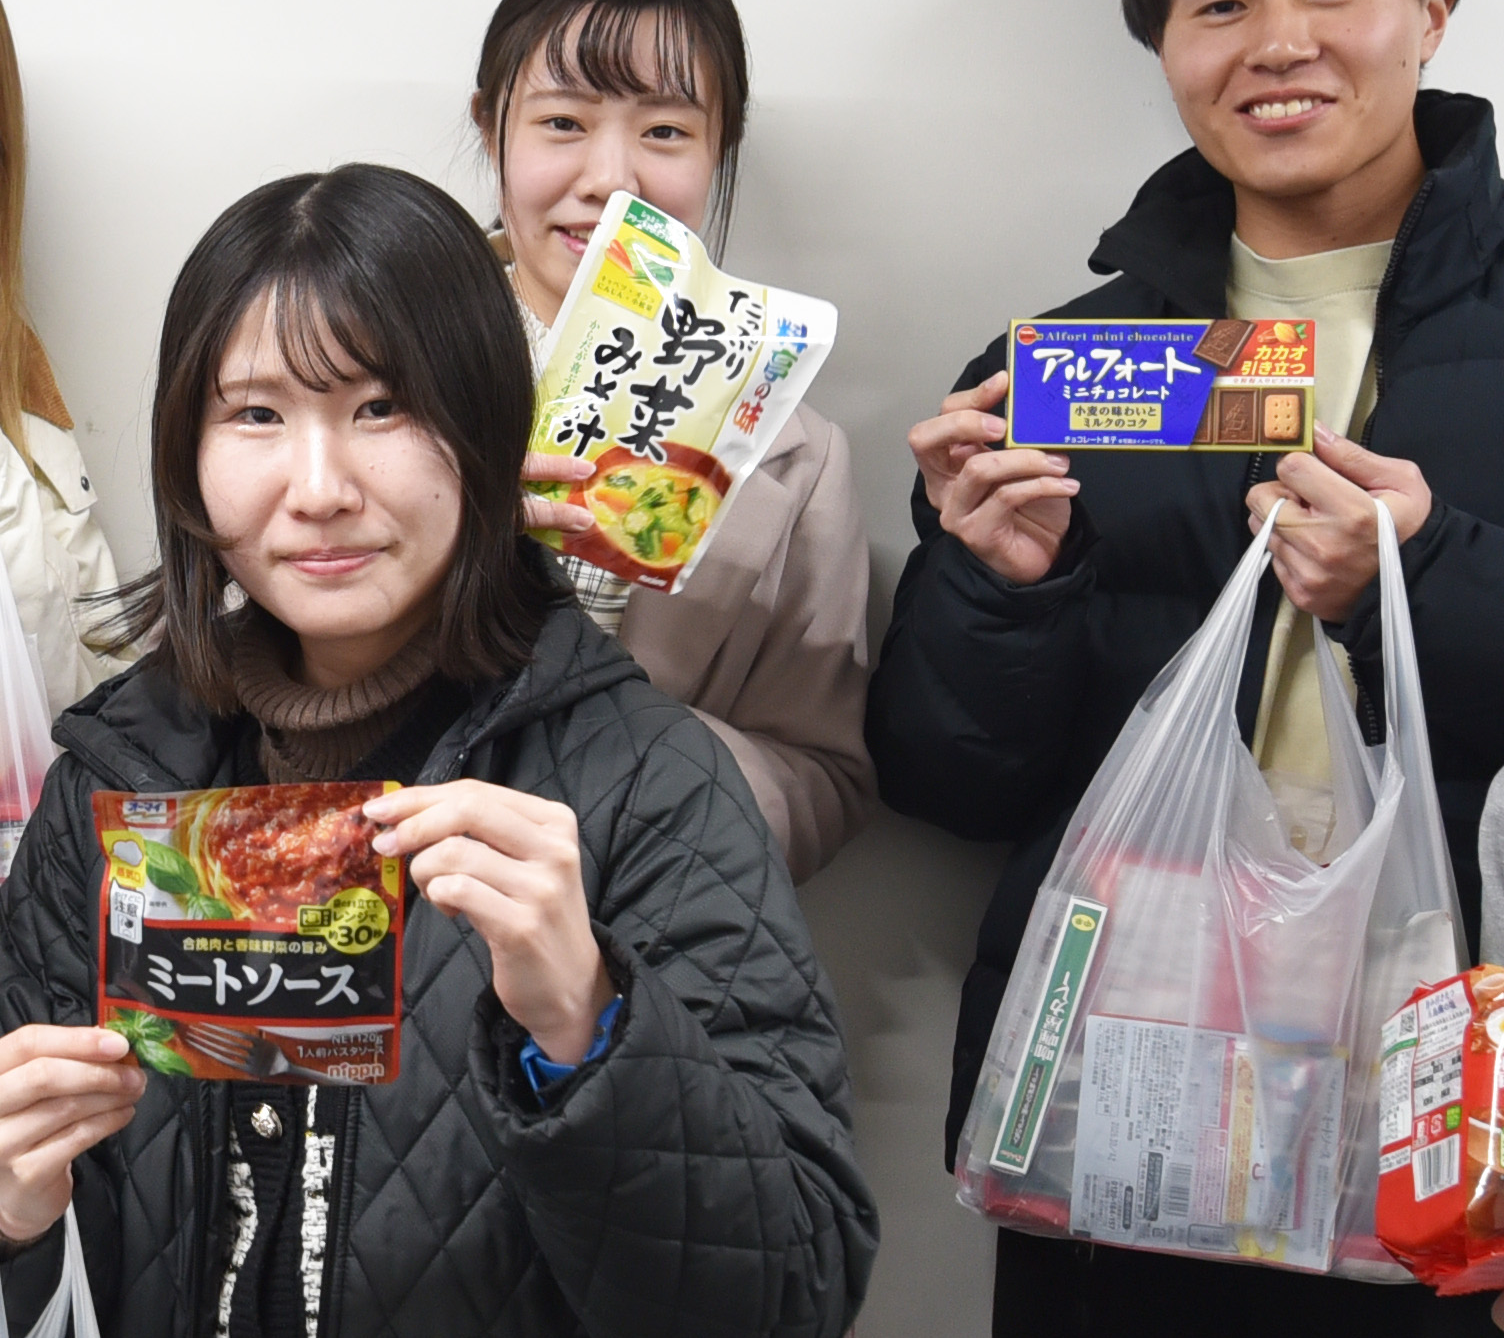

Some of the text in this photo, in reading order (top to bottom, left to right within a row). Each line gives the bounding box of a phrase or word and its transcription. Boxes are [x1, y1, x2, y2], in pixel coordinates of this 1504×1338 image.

[1045, 332, 1194, 342] Alfort mini chocolate
[1254, 345, 1308, 361] カカオ
[1032, 346, 1202, 384] アルフォート
[1241, 360, 1307, 376] 引き立つ
[616, 294, 726, 463] 野菜
[732, 317, 809, 437] 料亭の味
[556, 326, 644, 458] みそ汁
[1062, 385, 1170, 400] ミニチョコレート
[1075, 406, 1157, 417] 小麦の味わいと
[1083, 418, 1148, 428] ミルクのコク
[127, 802, 162, 813] オーマイ
[114, 901, 139, 918] 注意
[333, 910, 379, 923] レンジで
[182, 936, 328, 955] 合挽肉と香味野菜の旨み
[147, 953, 360, 1006] ミートソース
[327, 1062, 385, 1080] nippn
